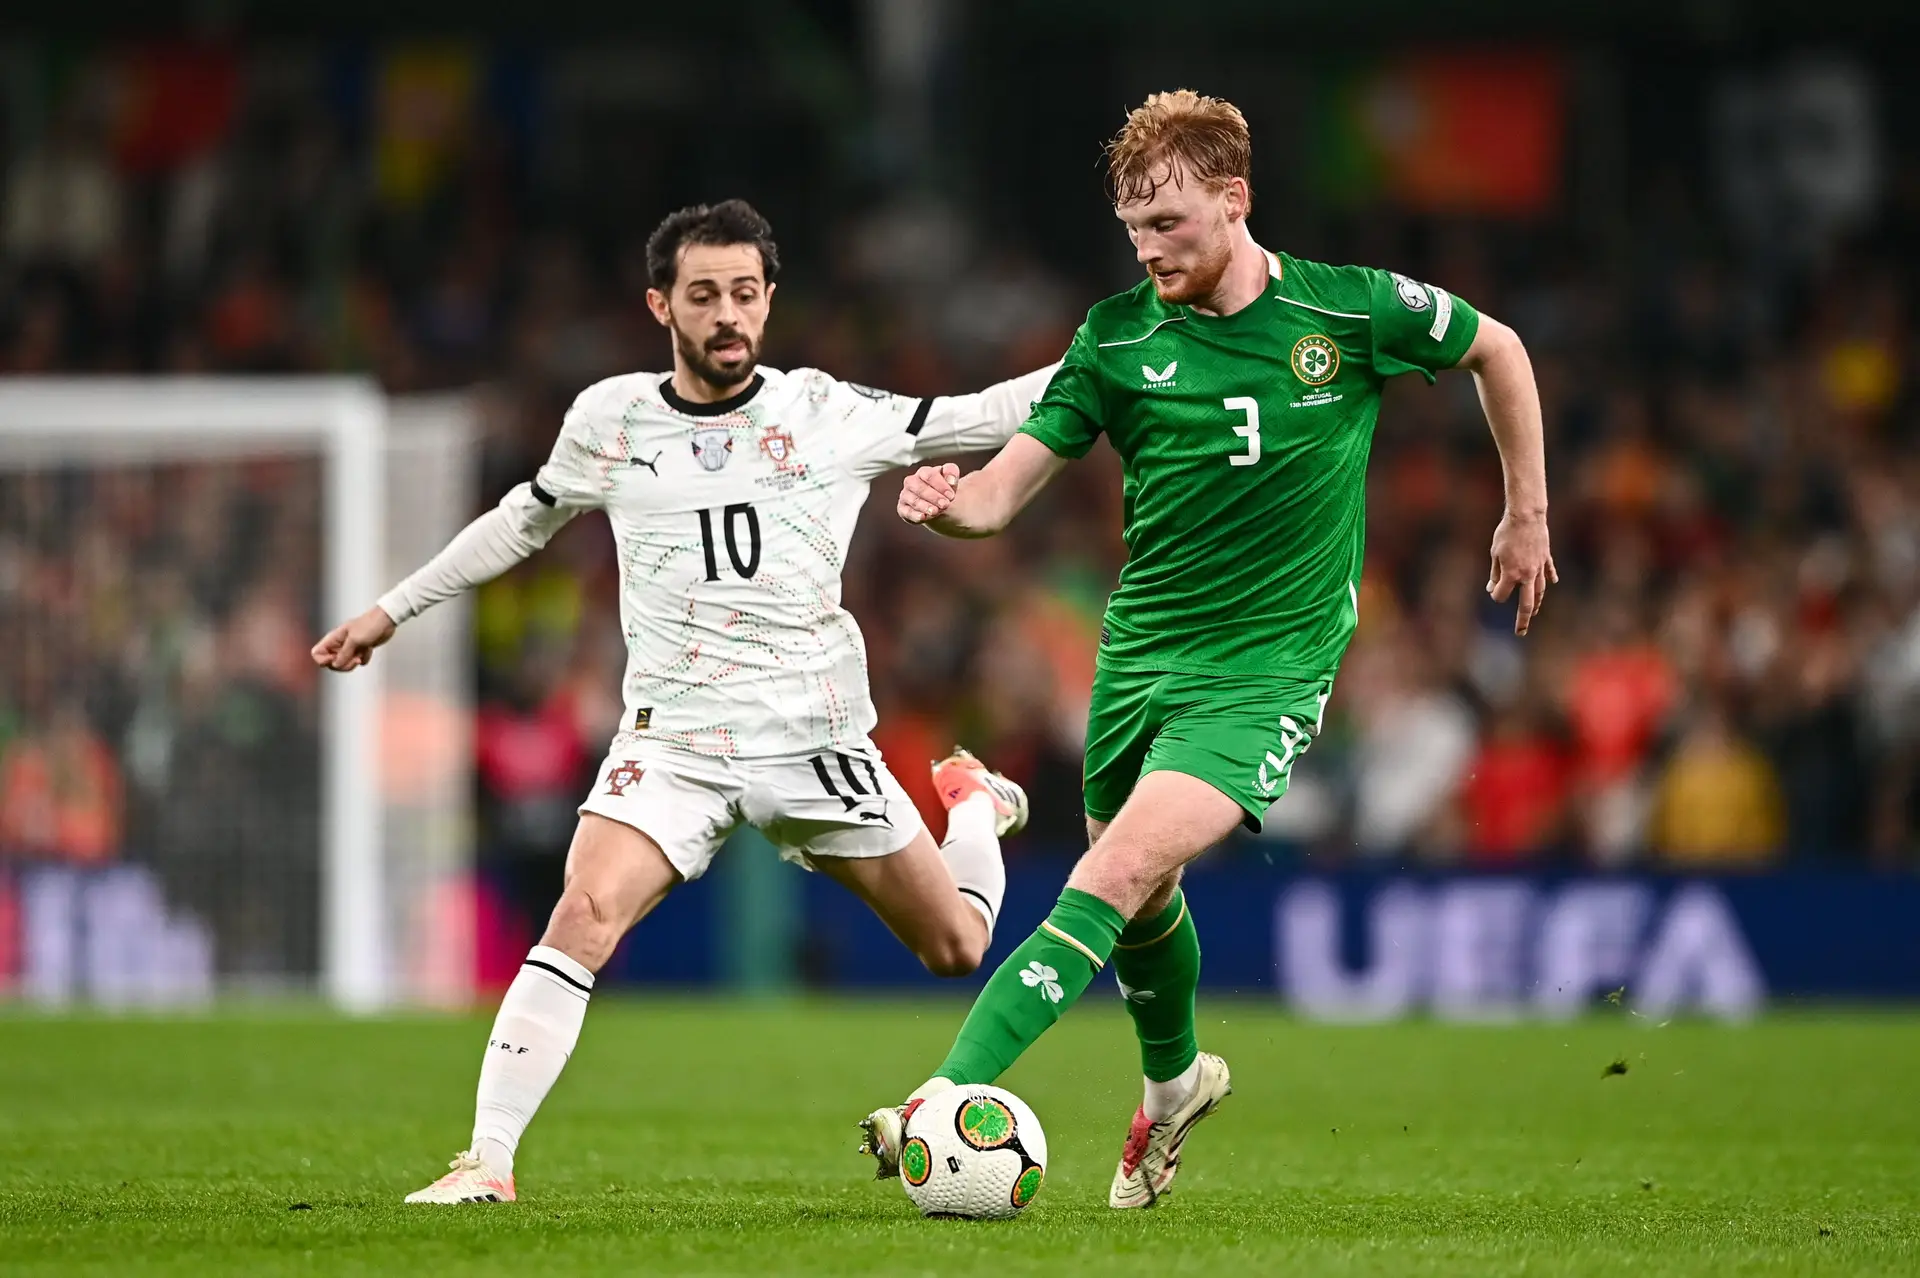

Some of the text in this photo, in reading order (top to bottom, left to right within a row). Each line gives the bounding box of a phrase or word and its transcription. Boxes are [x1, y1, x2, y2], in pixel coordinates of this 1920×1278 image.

[1295, 340, 1333, 356] IRELAND
[1142, 381, 1176, 389] CASTORE
[1302, 392, 1332, 401] PORTUGAL
[1302, 398, 1333, 407] NOVEMBER
[1223, 396, 1261, 466] 3
[694, 502, 761, 582] 10
[1265, 715, 1304, 773] 3
[806, 748, 883, 813] 10
[1278, 880, 1767, 1022] UEFA
